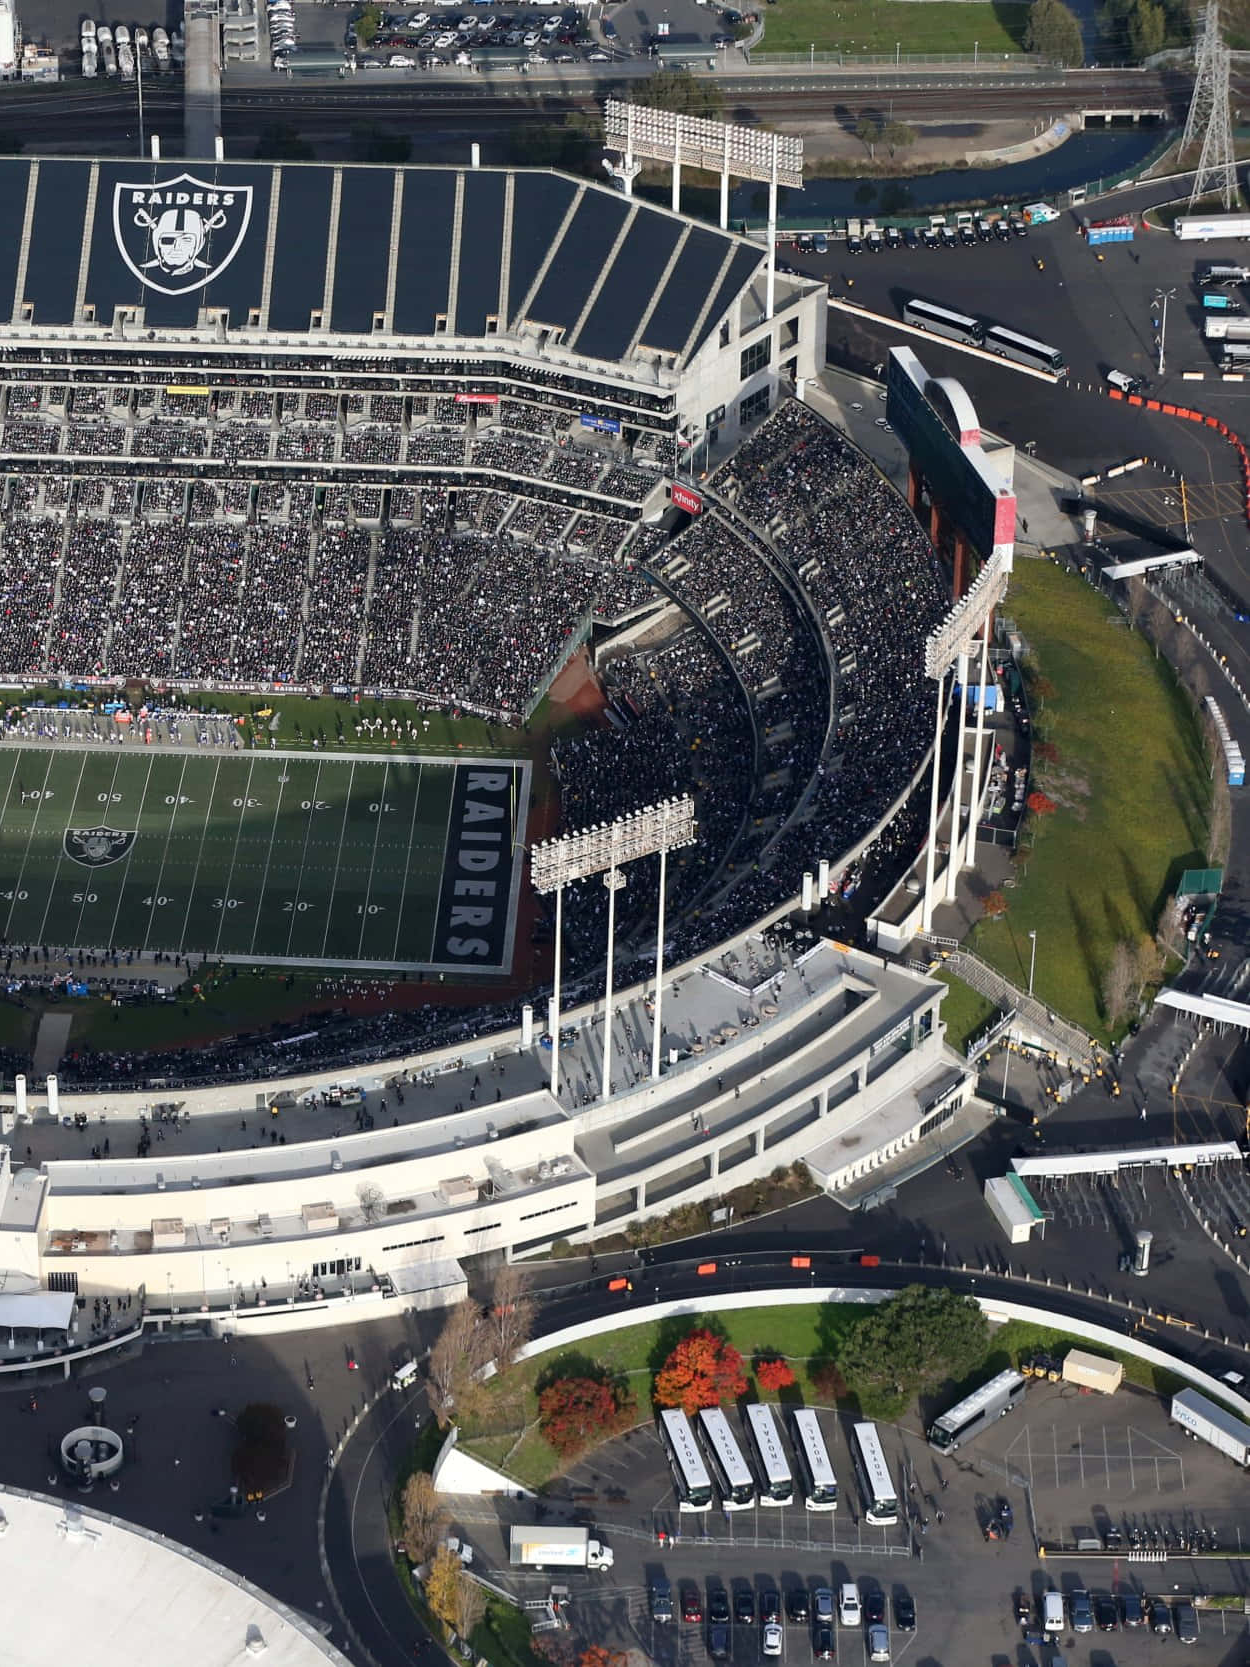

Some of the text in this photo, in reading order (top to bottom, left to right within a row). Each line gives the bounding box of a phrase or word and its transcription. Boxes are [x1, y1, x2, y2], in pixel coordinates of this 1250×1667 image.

[132, 191, 235, 206] RAIDERS
[674, 491, 700, 511] xfinity
[73, 830, 128, 838] RAIDERS
[446, 771, 509, 957] RAIDERS
[2, 890, 28, 900] 40
[72, 893, 98, 903] 50
[141, 896, 168, 906] 40
[211, 898, 238, 909] 30
[282, 901, 308, 912] 20
[356, 904, 378, 914] 10
[677, 1428, 696, 1465] ROYAL
[717, 1428, 737, 1463] ROYAL
[762, 1423, 778, 1460] ROYAL
